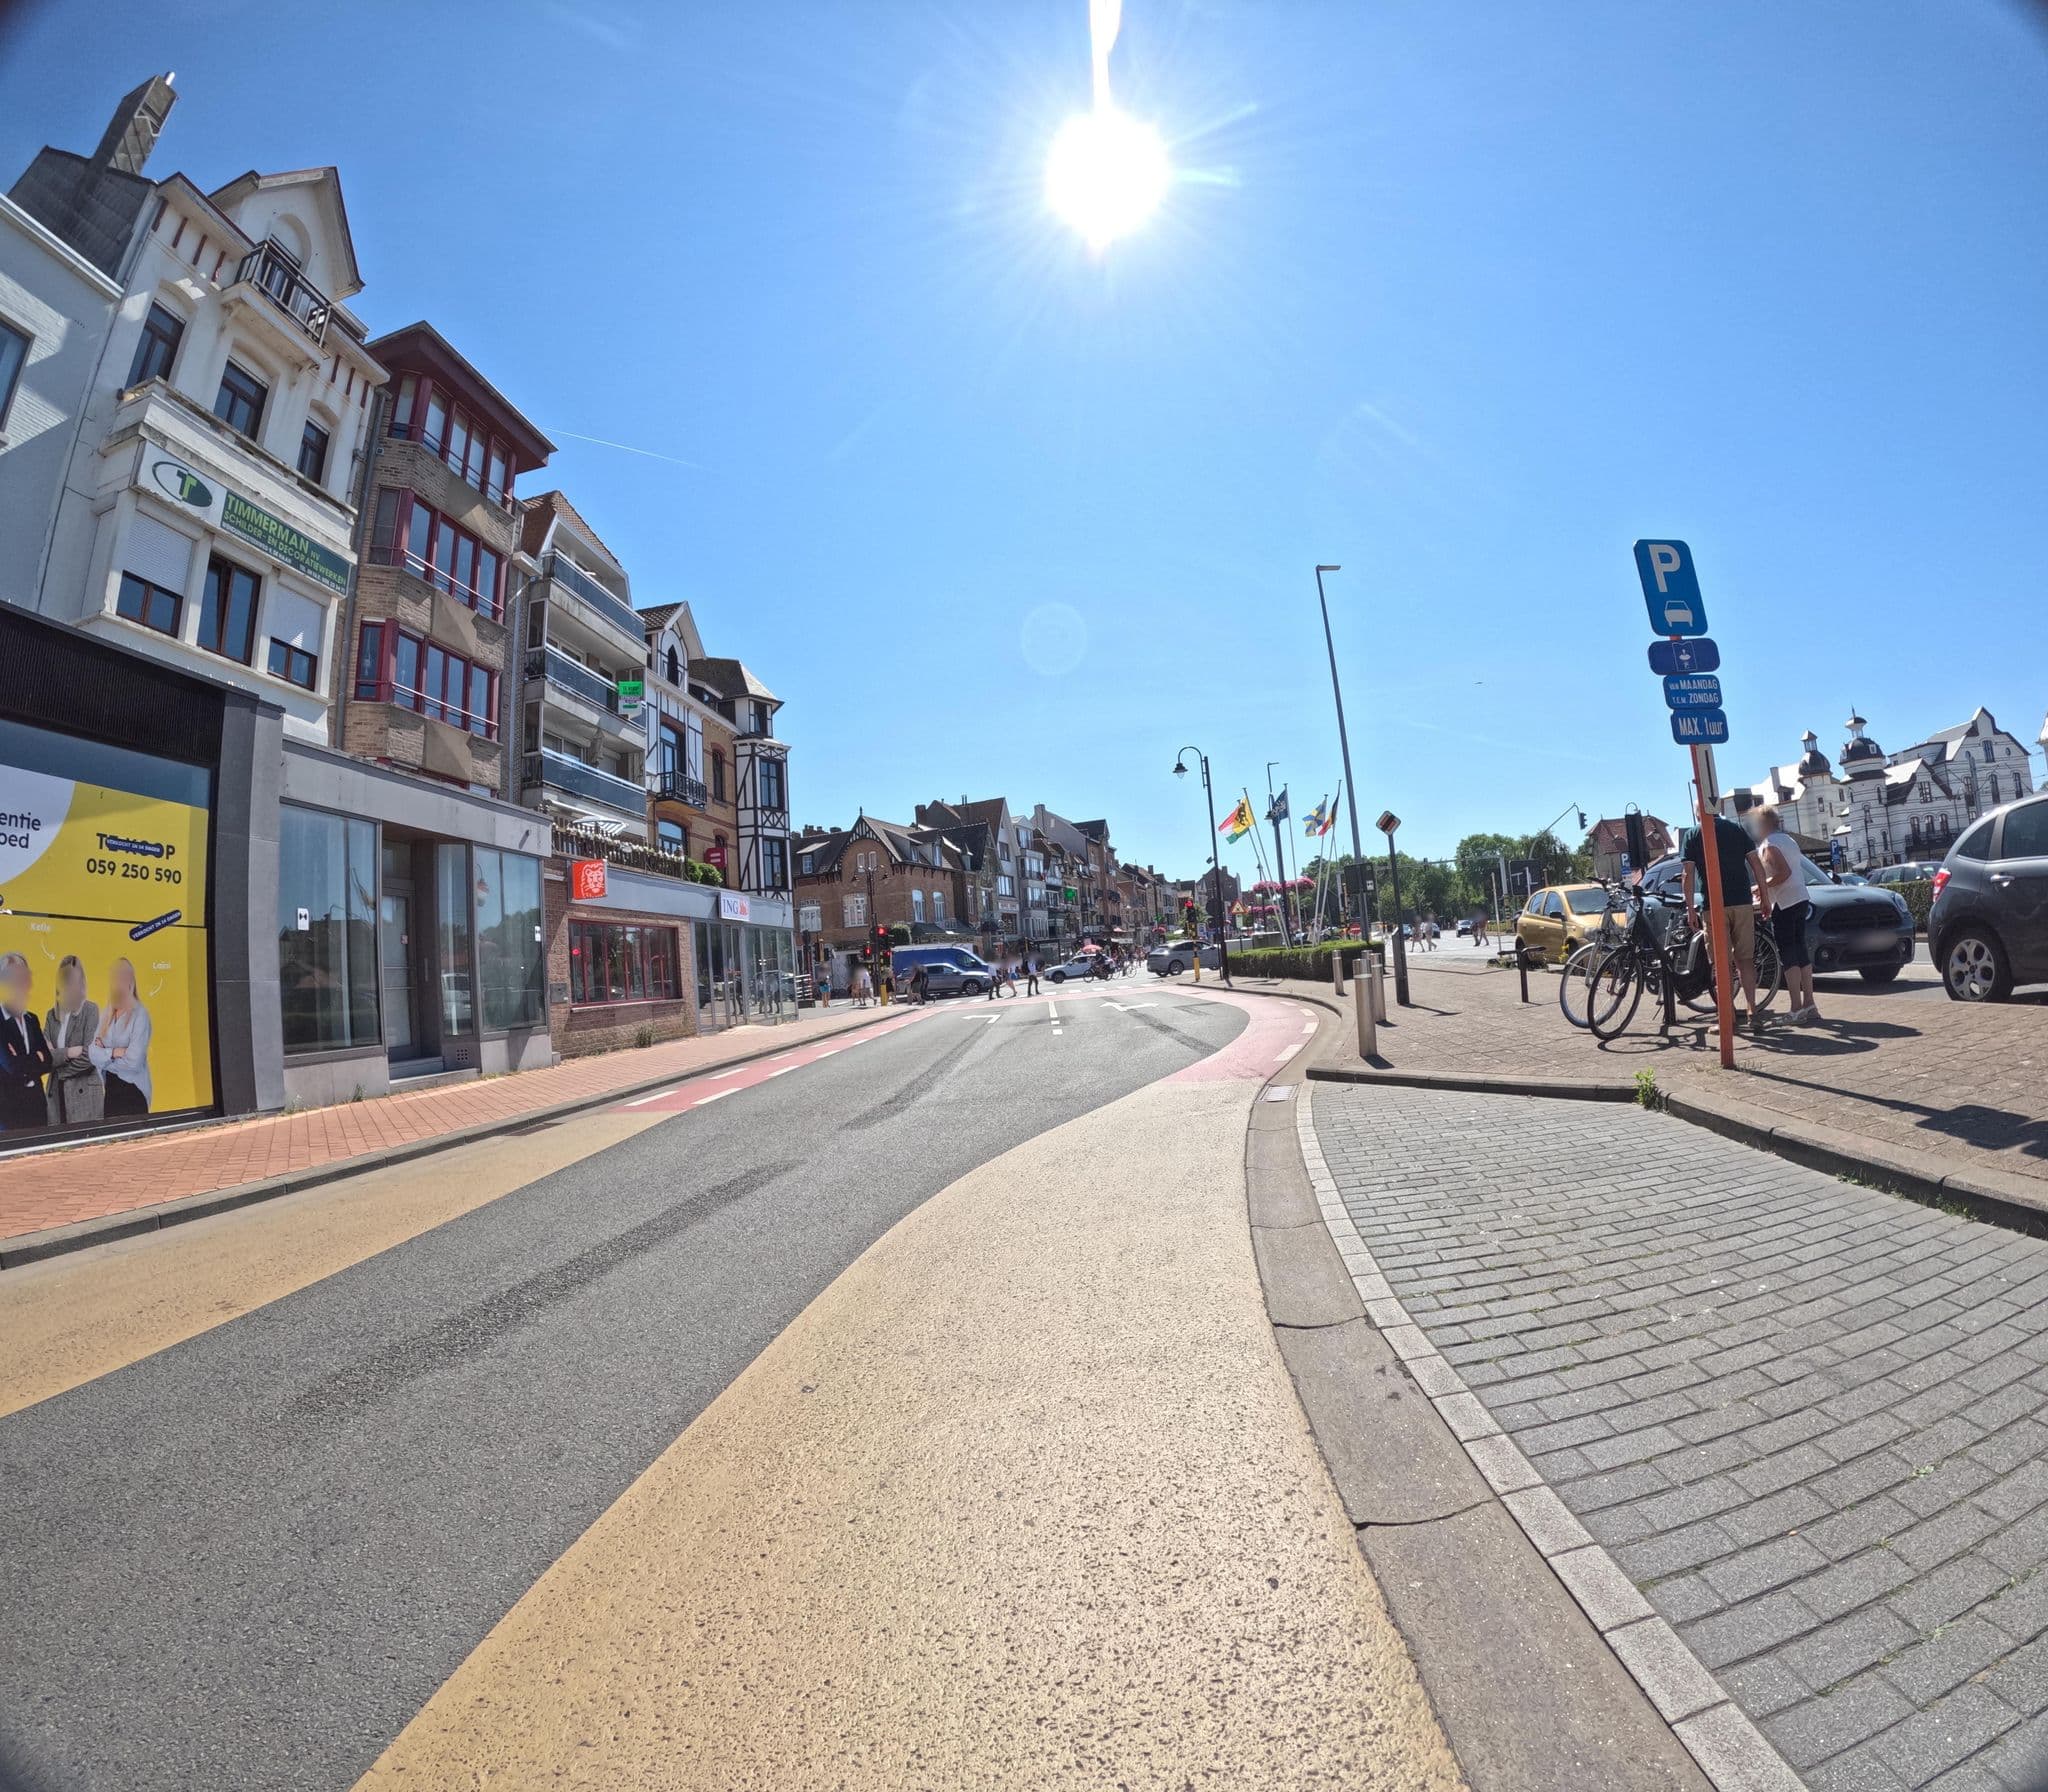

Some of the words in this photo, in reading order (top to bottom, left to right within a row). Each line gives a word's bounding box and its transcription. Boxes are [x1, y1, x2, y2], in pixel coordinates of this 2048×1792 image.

[227, 494, 310, 554] TIMMERMAN
[267, 536, 278, 547] EN
[1648, 544, 1681, 592] P
[1680, 679, 1718, 690] MAANDAG
[1688, 692, 1719, 704] ZONDAG
[1679, 717, 1703, 736] MAX.
[86, 858, 117, 876] 059
[121, 862, 150, 881] 250
[154, 867, 182, 885] 590
[723, 898, 739, 915] ING
